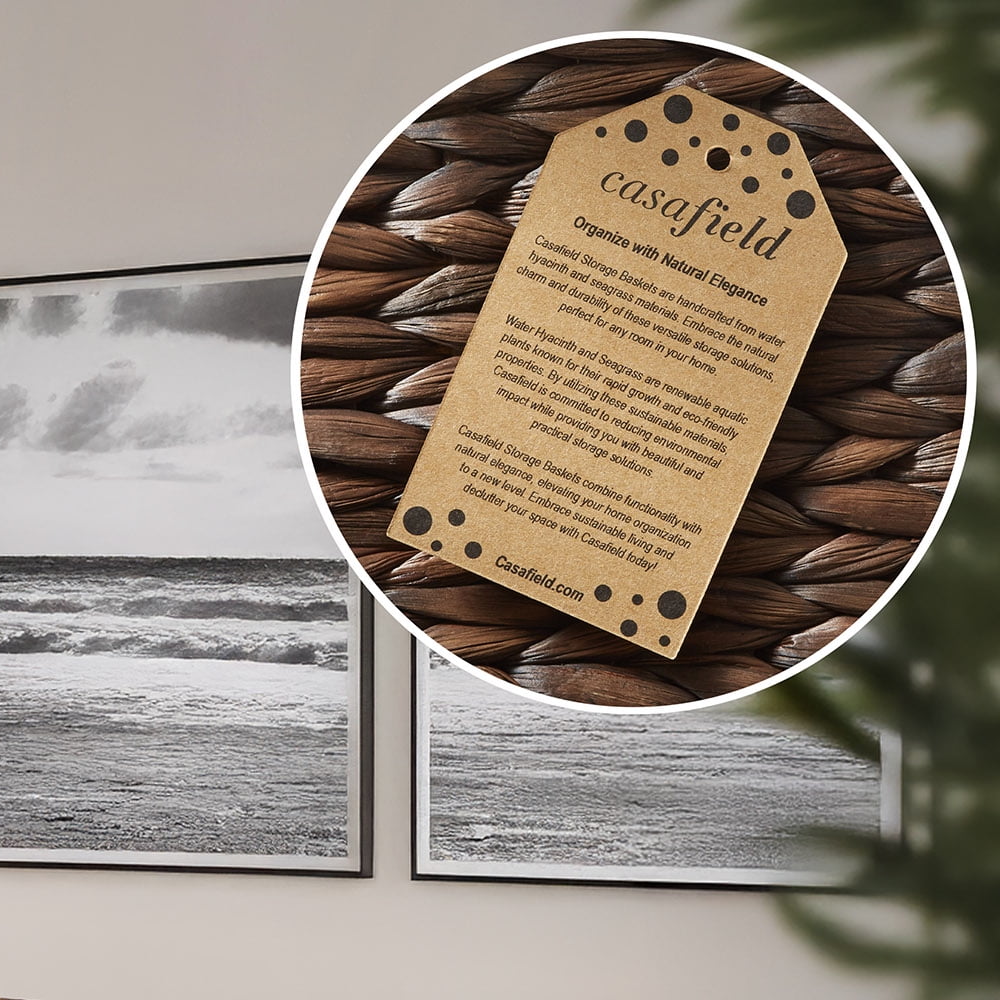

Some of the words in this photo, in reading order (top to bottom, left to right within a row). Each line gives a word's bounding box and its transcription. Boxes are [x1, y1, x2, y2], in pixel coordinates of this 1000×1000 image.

[572, 214, 631, 249] Organize
[630, 241, 660, 262] with
[659, 251, 711, 282] Natural
[707, 271, 768, 307] Elegance
[599, 170, 793, 261] casafield
[515, 264, 548, 285] charm
[546, 278, 570, 293] and
[566, 285, 613, 314] durability
[611, 305, 626, 316] of
[622, 308, 651, 328] these
[651, 322, 693, 346] versatile
[691, 339, 730, 362] storage
[729, 355, 774, 383] solutions,
[527, 248, 570, 275] hyacinth
[568, 269, 592, 284] and
[588, 277, 635, 303] seagrass
[632, 296, 679, 323] materials.
[681, 314, 726, 341] Embrace
[725, 333, 743, 349] the
[742, 342, 780, 364] natural
[533, 233, 582, 262] Casafield
[579, 253, 618, 278] Storage
[617, 269, 659, 295] Baskets
[657, 288, 676, 302] are
[675, 293, 736, 326] handcrafted
[732, 317, 757, 337] from
[756, 329, 786, 348] water
[556, 301, 595, 323] perfect
[592, 314, 610, 329] for
[607, 322, 629, 339] any
[626, 331, 655, 349] room
[653, 339, 666, 353] in
[663, 346, 690, 363] your
[687, 353, 717, 377] home.
[492, 348, 545, 377] properties.
[546, 367, 563, 385] By
[561, 376, 600, 401] utilizing
[598, 390, 628, 411] these
[626, 404, 683, 434] sustainable
[681, 428, 728, 456] materials,
[492, 363, 540, 392] Casafield
[536, 382, 549, 396] is
[547, 390, 601, 418] committed
[597, 409, 610, 422] to
[609, 416, 653, 443] reducing
[652, 434, 723, 469] environmental
[498, 332, 532, 352] plants
[530, 342, 564, 366] known
[563, 357, 580, 372] for
[577, 363, 603, 381] their
[601, 375, 630, 393] rapid
[625, 386, 662, 407] growth
[660, 401, 684, 416] and
[681, 409, 739, 442] eco-friendly
[504, 312, 536, 334] Water
[532, 325, 578, 353] Hyacinth
[576, 346, 600, 361] and
[597, 352, 644, 381] Seagrass
[643, 374, 662, 388] are
[660, 382, 712, 410] renewable
[711, 403, 749, 425] aquatic
[457, 423, 505, 451] Casafield
[502, 442, 542, 468] Storage
[541, 458, 582, 485] Baskets
[581, 478, 624, 502] combine
[622, 493, 682, 528] functionality
[680, 519, 703, 536] with
[494, 383, 531, 407] impact
[528, 400, 556, 418] while
[553, 411, 601, 439] providing
[598, 430, 620, 445] you
[619, 438, 641, 454] with
[639, 445, 685, 472] beautiful
[682, 465, 706, 481] and
[527, 419, 574, 443] practical
[570, 436, 609, 459] storage
[608, 452, 653, 479] solutions.
[453, 442, 491, 464] natural
[488, 456, 534, 485] elegance,
[536, 477, 581, 505] elevating
[578, 495, 605, 512] your
[602, 503, 632, 524] home
[631, 518, 692, 550] organization
[458, 460, 471, 474] to
[469, 467, 479, 478] a
[477, 471, 502, 487] new
[526, 489, 572, 517] Embrace
[571, 511, 627, 541] sustainable
[625, 531, 654, 554] living
[652, 545, 676, 561] and
[461, 482, 506, 508] declutter
[502, 501, 530, 517] your
[527, 511, 558, 530] space
[558, 523, 580, 540] with
[579, 530, 628, 559] Casafield
[624, 550, 659, 573] today!
[493, 553, 585, 602] Casafield.com
